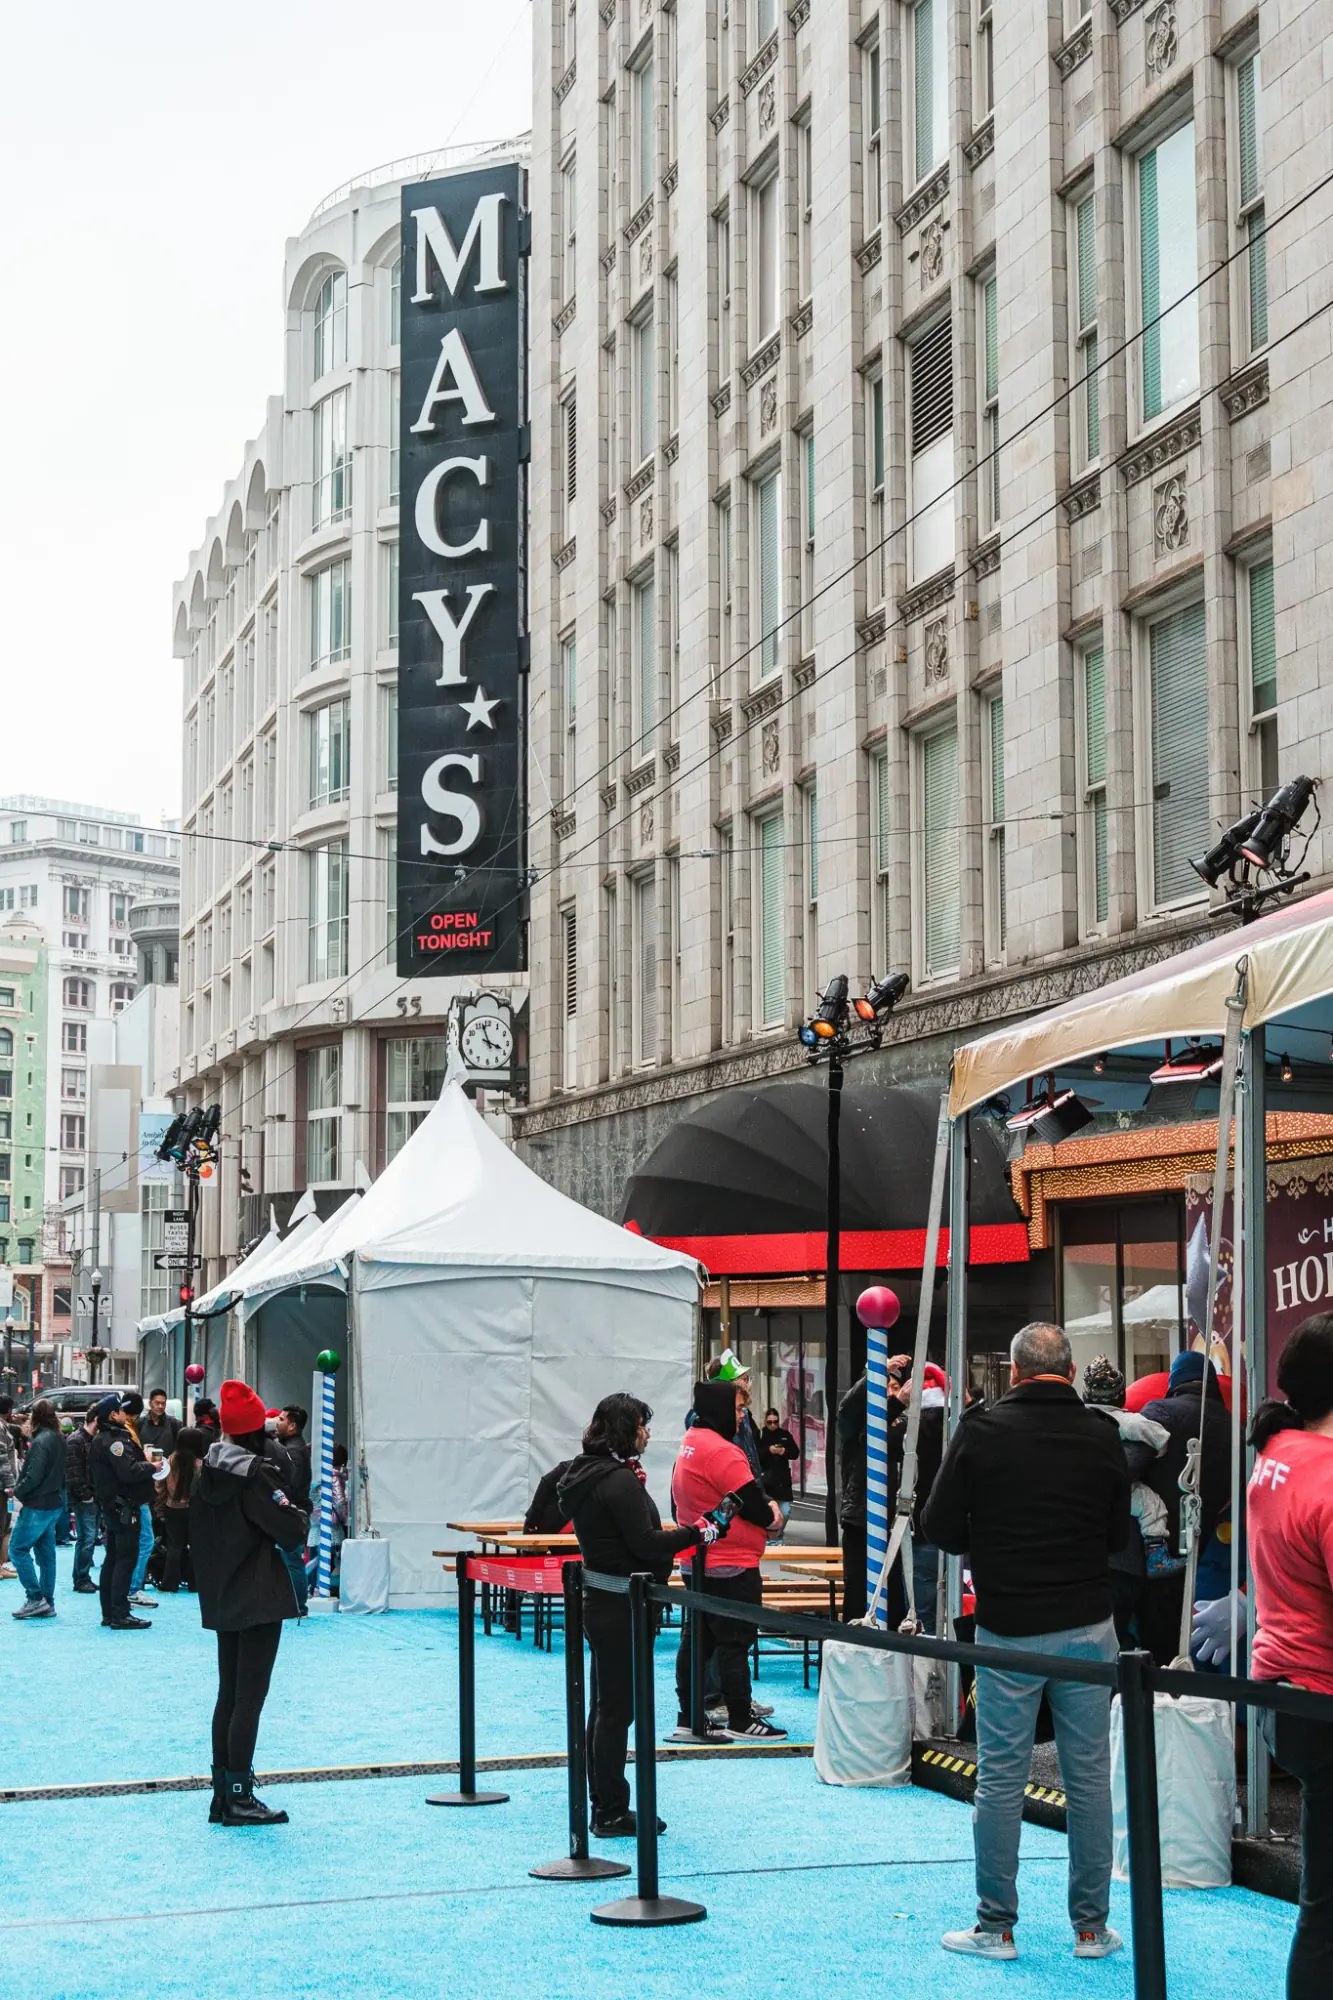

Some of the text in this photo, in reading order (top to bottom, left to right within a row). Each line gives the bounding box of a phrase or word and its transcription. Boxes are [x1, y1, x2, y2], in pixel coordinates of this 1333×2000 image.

[431, 912, 478, 930] OPEN
[417, 931, 492, 951] TONIGHT
[396, 996, 422, 1018] 55
[475, 1022, 482, 1030] 11
[168, 1258, 181, 1266] ONE
